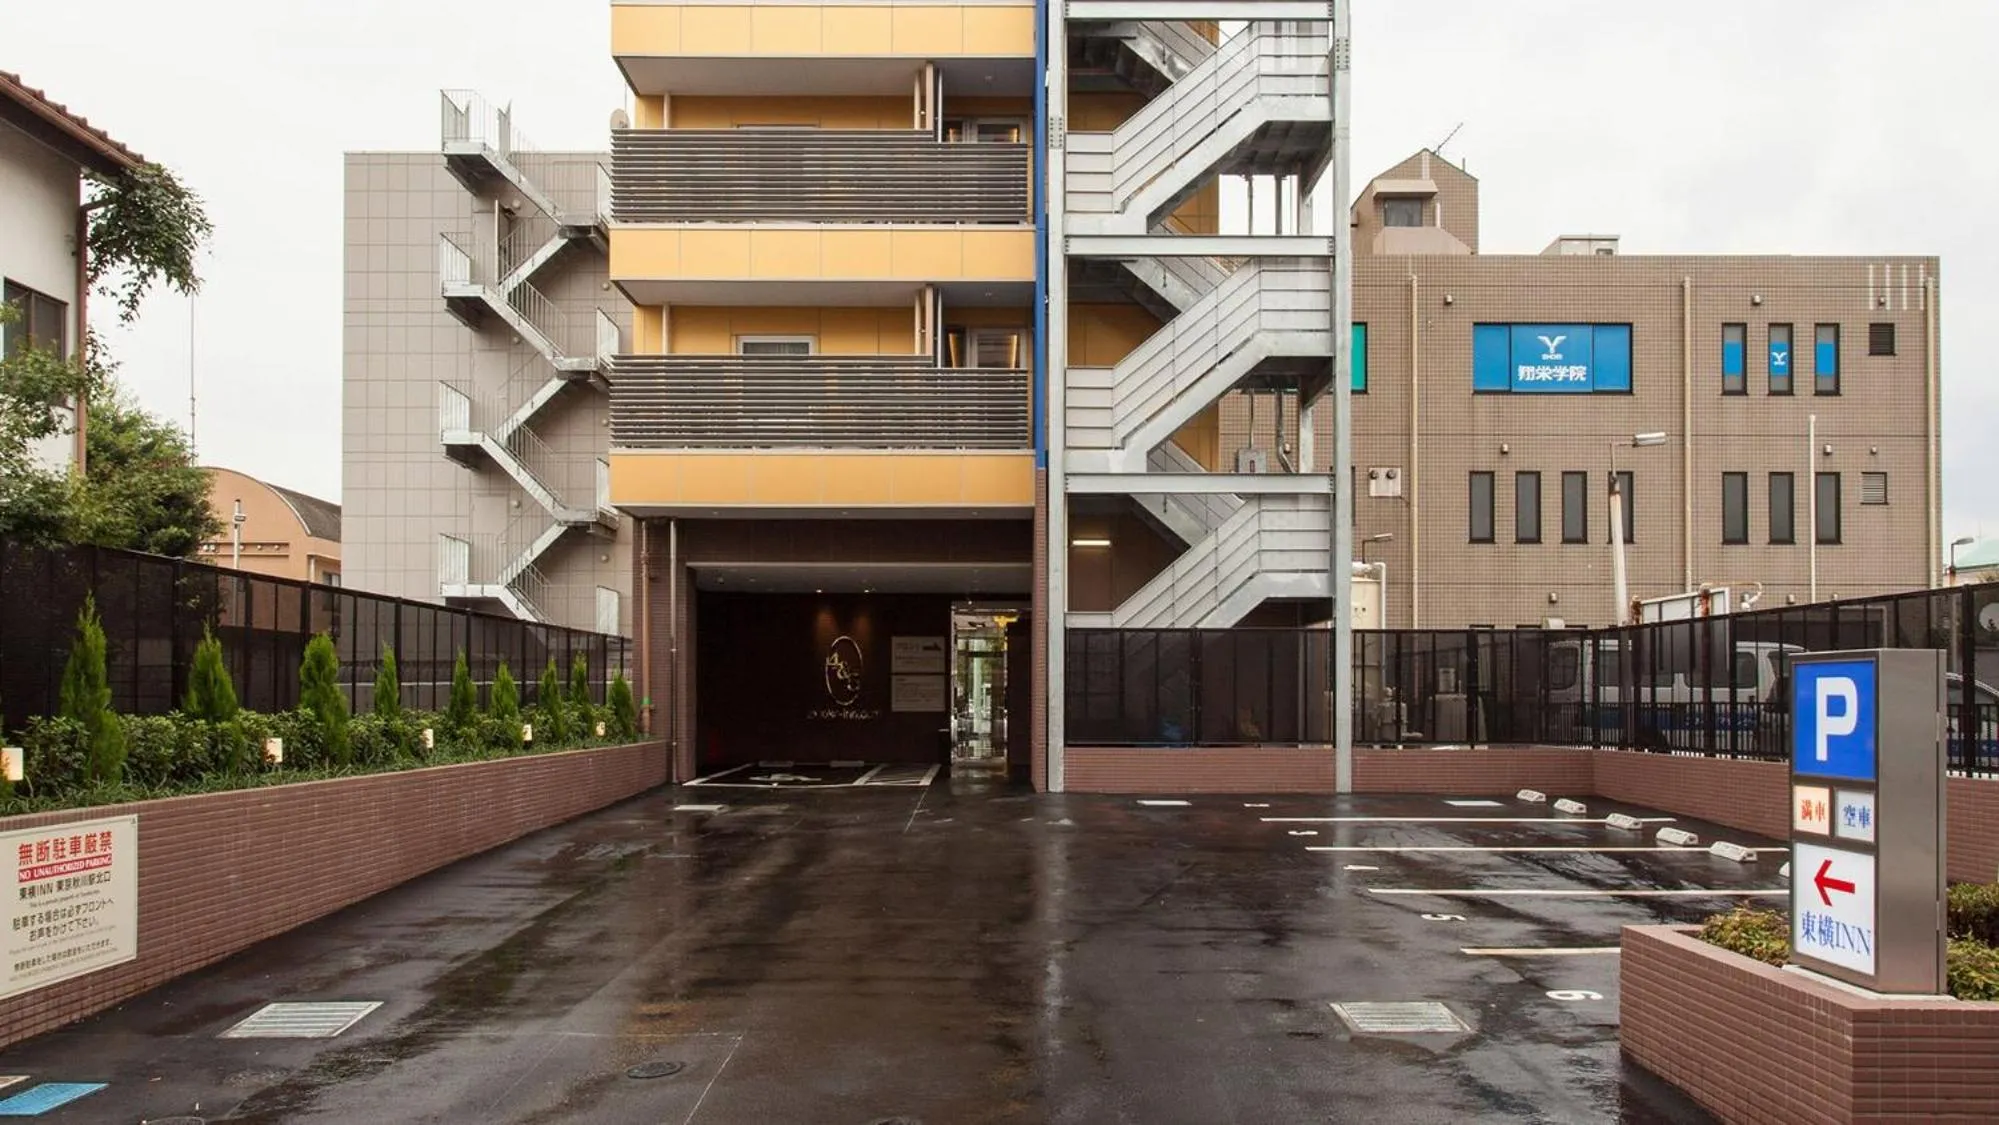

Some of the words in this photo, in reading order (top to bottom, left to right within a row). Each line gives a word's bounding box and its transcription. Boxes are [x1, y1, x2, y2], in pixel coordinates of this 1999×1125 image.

[1518, 365, 1587, 381] 翔栄学院
[1815, 676, 1858, 761] P
[1801, 799, 1826, 823] 満車
[1843, 804, 1871, 829] 空車
[19, 831, 112, 866] 無断駐車厳禁
[19, 869, 31, 881] NO
[33, 860, 84, 878] UNAUTHORIZED
[86, 854, 112, 869] PARKING
[1801, 911, 1871, 956] 東横INN
